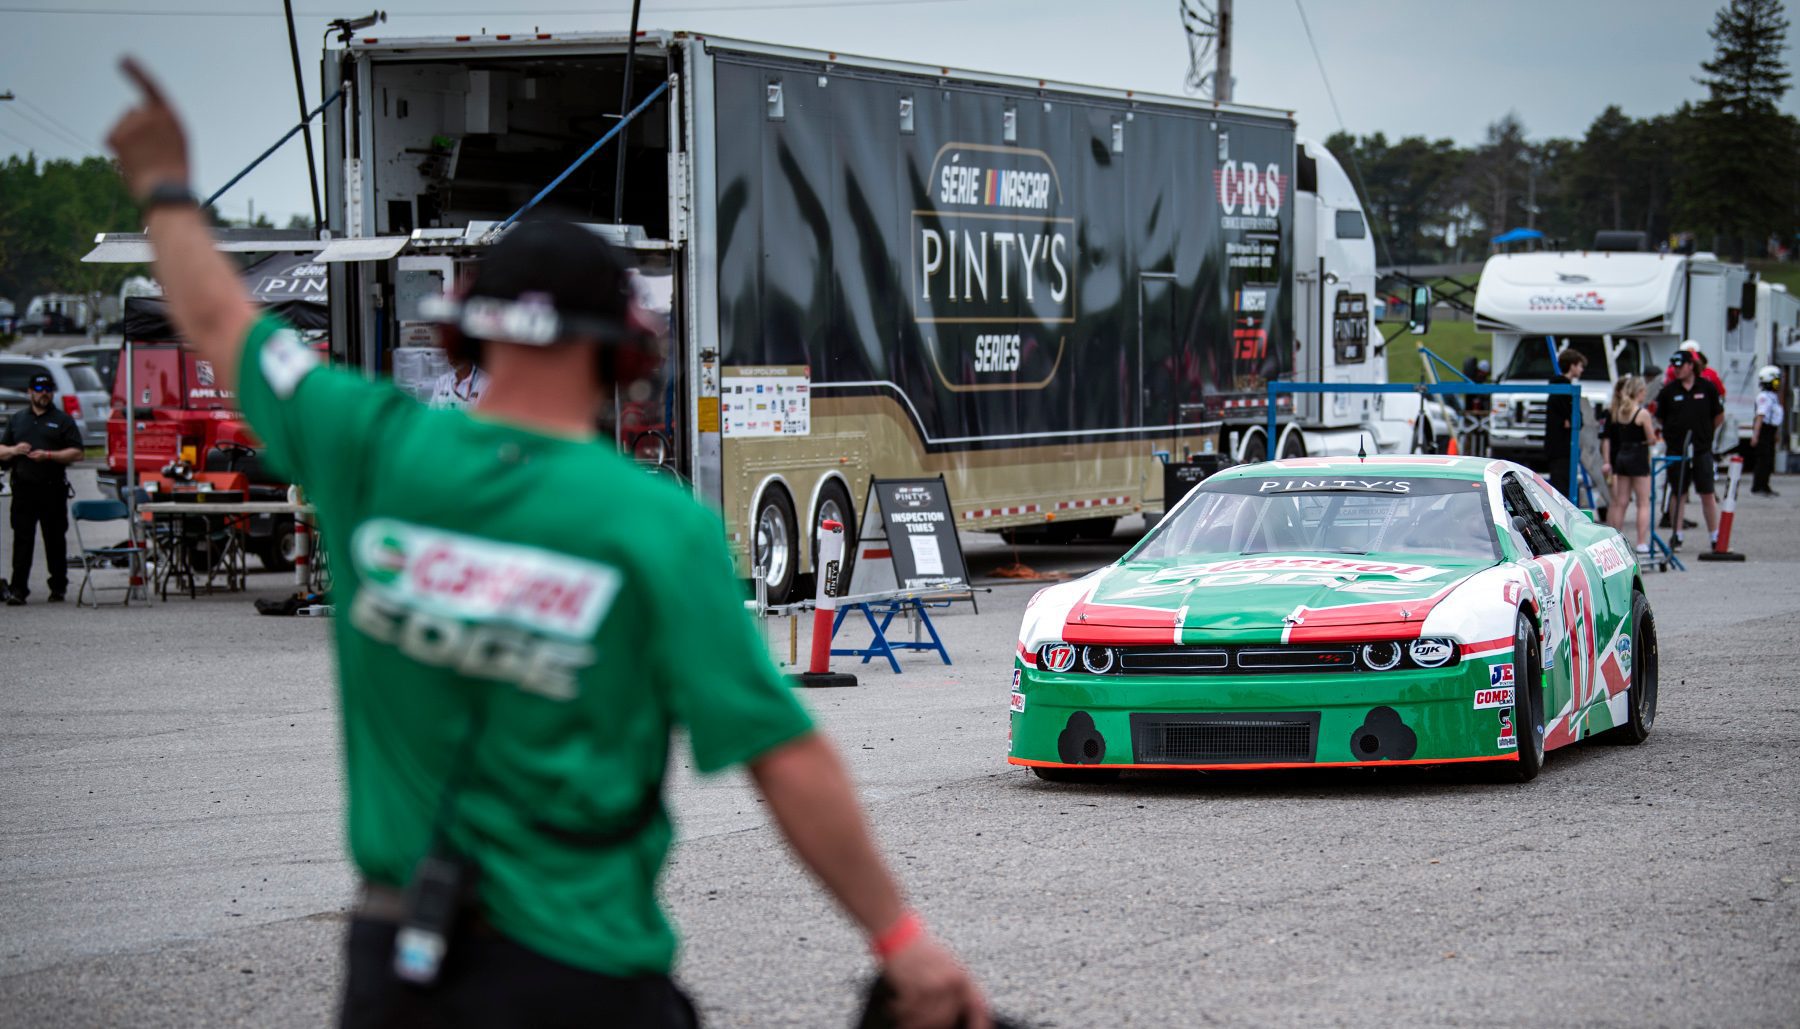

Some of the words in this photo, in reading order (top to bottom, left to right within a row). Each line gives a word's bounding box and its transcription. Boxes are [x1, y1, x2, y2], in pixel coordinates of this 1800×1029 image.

[941, 154, 981, 205] SÉRIE
[1000, 170, 1050, 209] NASCAR
[922, 229, 1068, 303] PINTY'S
[974, 334, 1020, 373] SERIES
[1259, 480, 1411, 493] PINTY'S
[894, 492, 931, 501] PINTY'S
[891, 511, 945, 523] INSPECTION
[905, 522, 935, 533] TIMES
[1561, 560, 1596, 718] 17
[1049, 648, 1071, 669] 17
[1414, 645, 1442, 655] DJK
[1491, 664, 1514, 686] JE
[1476, 689, 1509, 705] COMP
